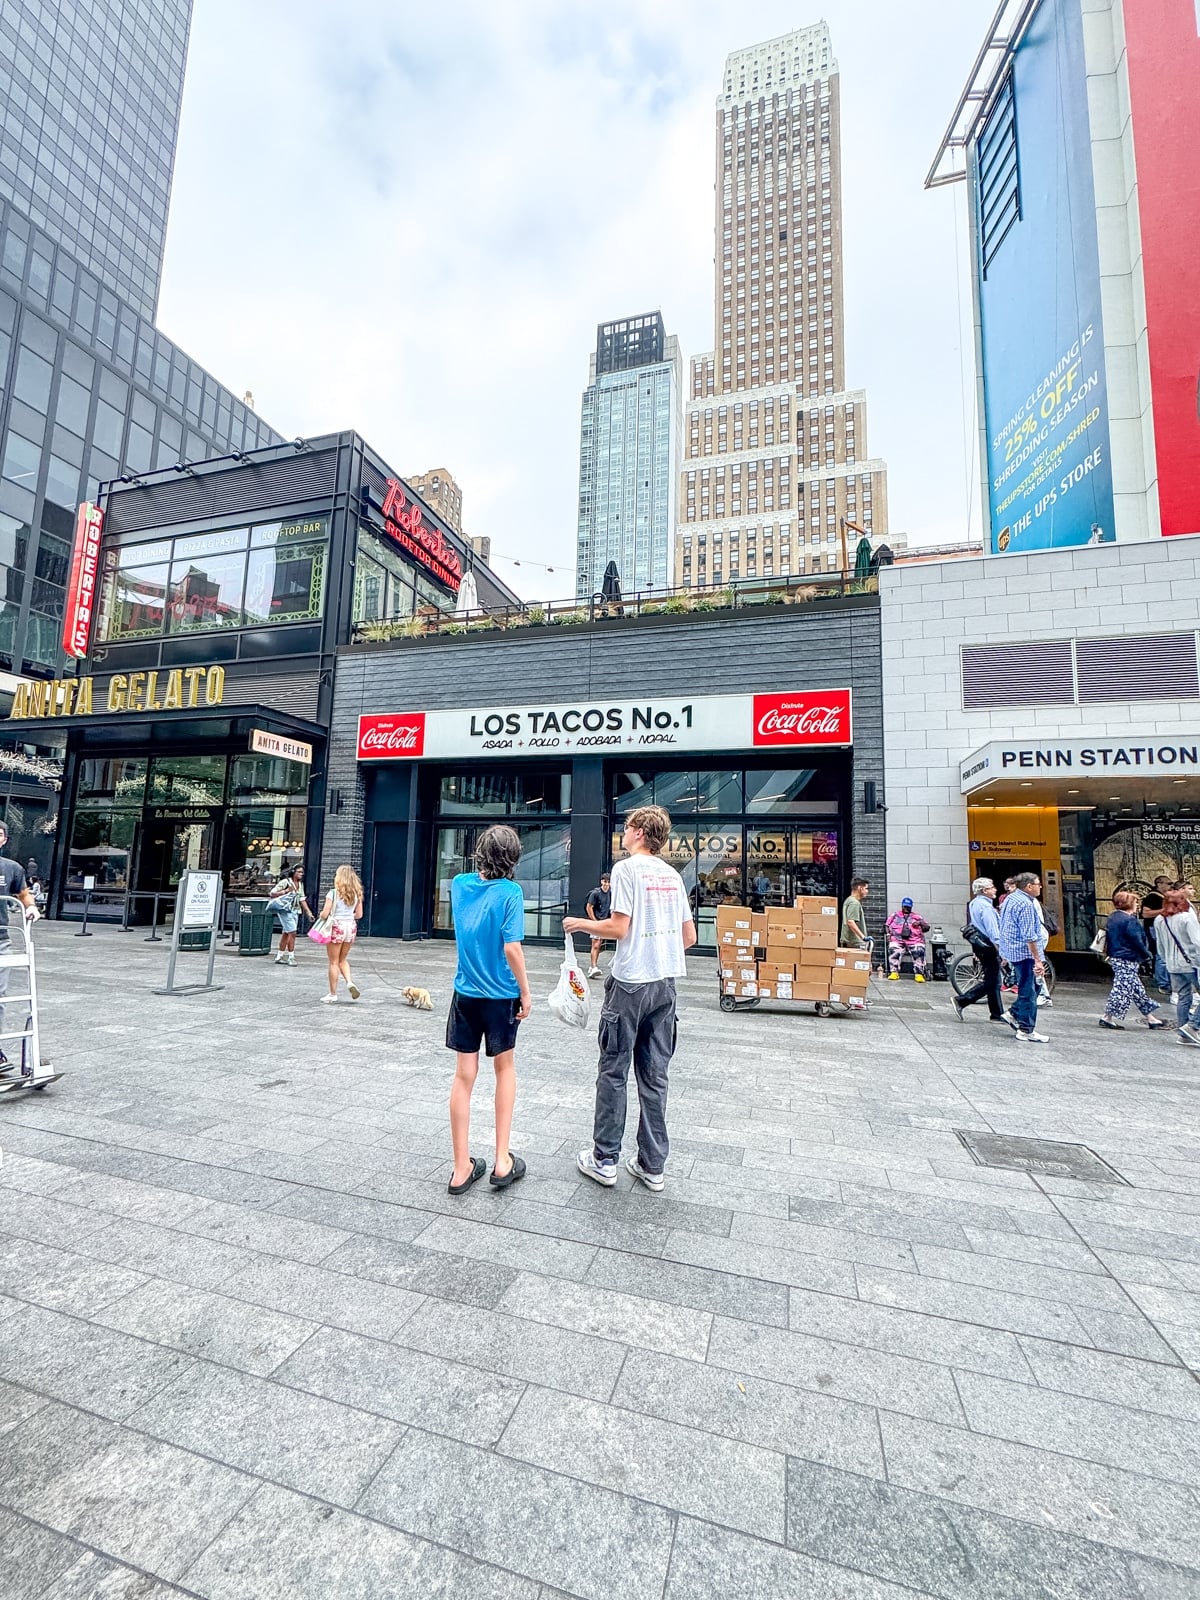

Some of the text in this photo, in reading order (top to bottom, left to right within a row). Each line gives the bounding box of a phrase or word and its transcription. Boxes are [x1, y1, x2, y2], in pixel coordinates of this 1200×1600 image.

[993, 324, 1093, 450] SPRING CLEANING IS
[993, 370, 1098, 492] SHREDDING SEASON
[1005, 412, 1038, 462] 25%
[995, 407, 1100, 516] THEUPSSTORE.COM/SHRED
[1031, 446, 1049, 467] VISIT
[1023, 456, 1062, 499] FOR DETAILS
[1013, 446, 1102, 537] THE UPS STORE
[183, 541, 206, 553] PIZZA
[215, 535, 240, 547] PASTA
[262, 522, 321, 540] ROOFTOP BAR
[386, 520, 460, 592] ROOFTOP DINING
[9, 665, 226, 719] ANITA GELATO
[470, 705, 693, 736] LOS TACOS No.1
[757, 706, 846, 736] Coca-Cola
[257, 735, 309, 758] ANITA GELATO
[361, 726, 421, 750] Coca-Cola
[481, 734, 678, 749] ASADA POLLO ADOBADA NOPAL
[1002, 746, 1198, 768] PENN STATION
[1142, 824, 1154, 832] 34
[1155, 824, 1192, 832] St-Penn
[1143, 832, 1179, 841] Subway
[668, 835, 738, 852] TACOS
